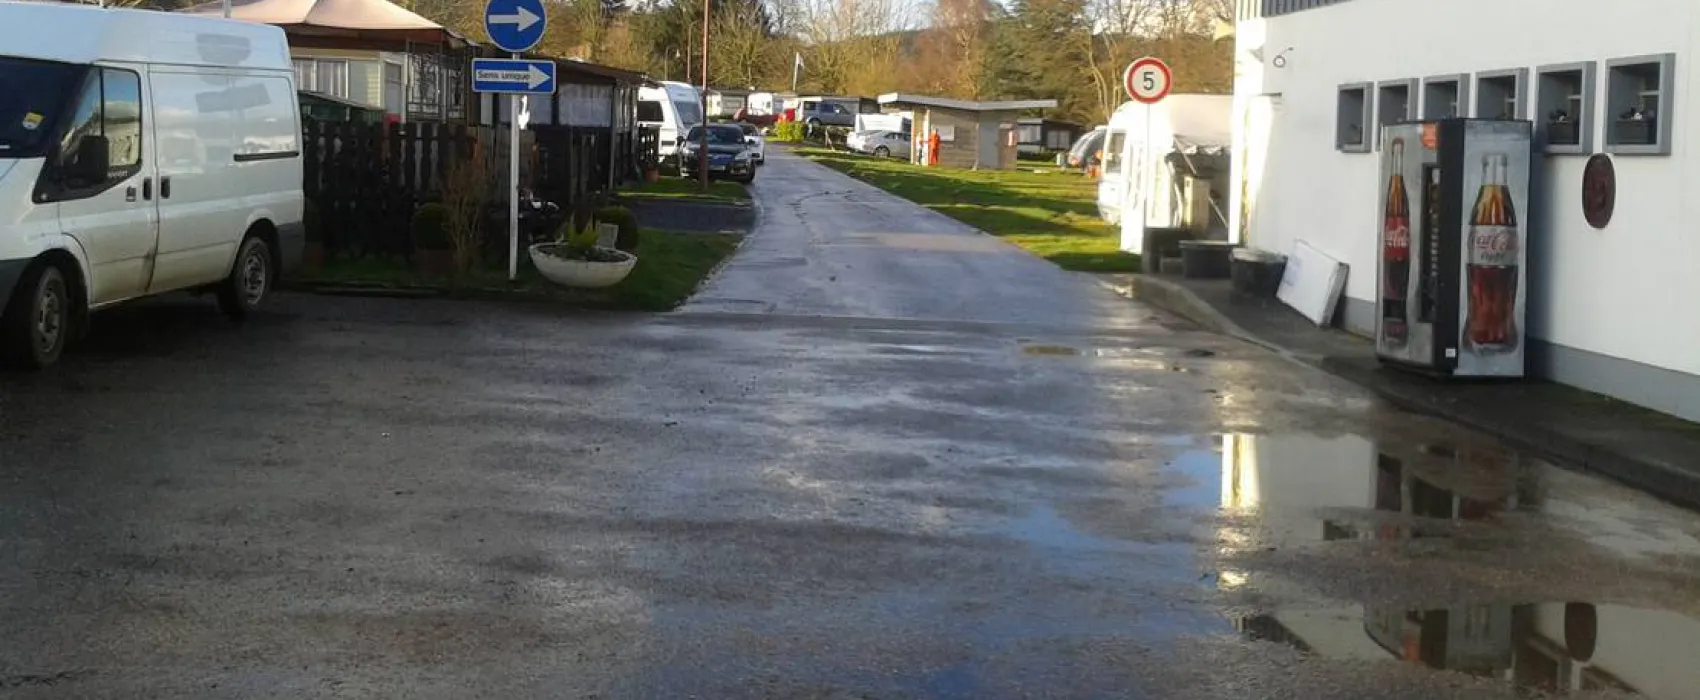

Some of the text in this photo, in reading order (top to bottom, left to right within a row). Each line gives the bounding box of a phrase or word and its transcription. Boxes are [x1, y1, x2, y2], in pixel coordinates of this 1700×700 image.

[477, 70, 530, 82] Sens unique
[1143, 71, 1154, 91] 5
